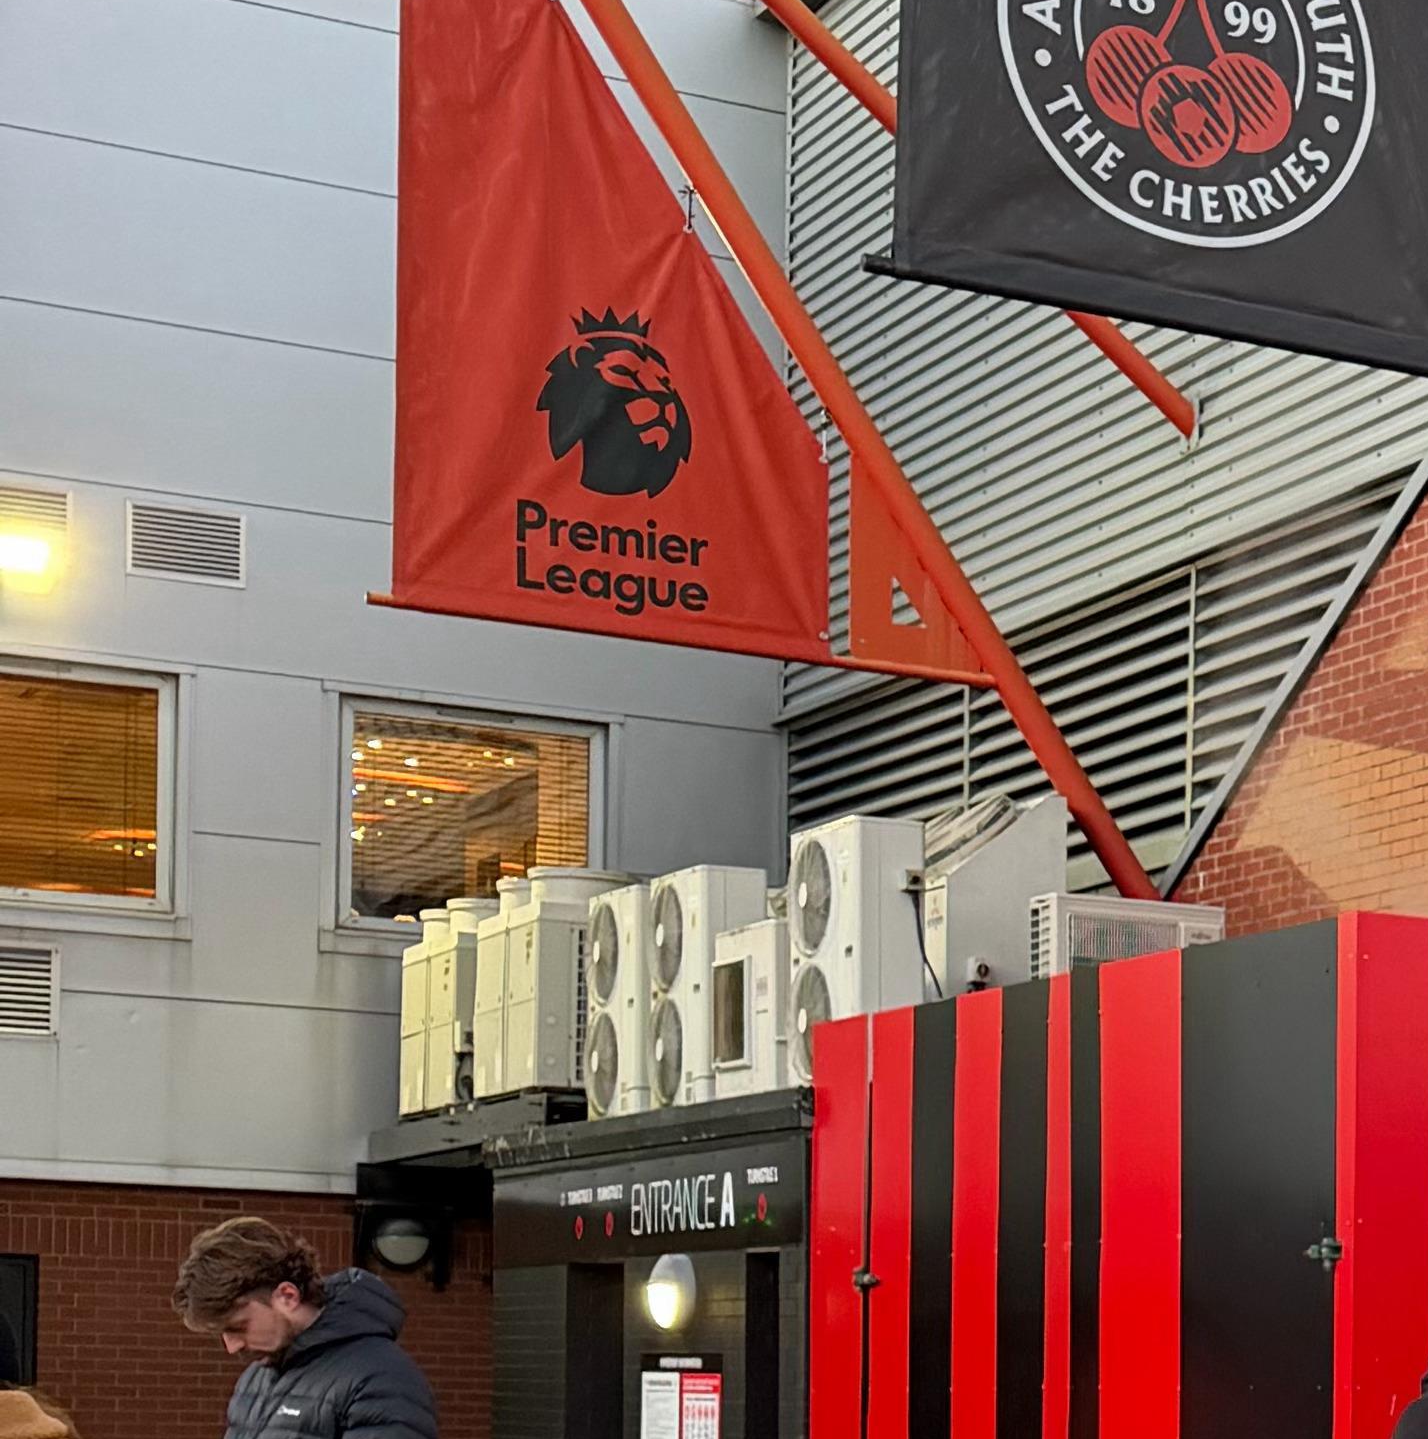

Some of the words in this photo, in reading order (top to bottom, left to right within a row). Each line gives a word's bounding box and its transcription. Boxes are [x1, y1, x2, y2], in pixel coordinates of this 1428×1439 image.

[1223, 2, 1277, 44] 99
[1044, 83, 1126, 183] THE
[1129, 136, 1331, 224] CHERRIES
[516, 499, 709, 566] Premier
[516, 546, 709, 616] League
[631, 1174, 716, 1236] ENTRANCE
[720, 1171, 735, 1227] A
